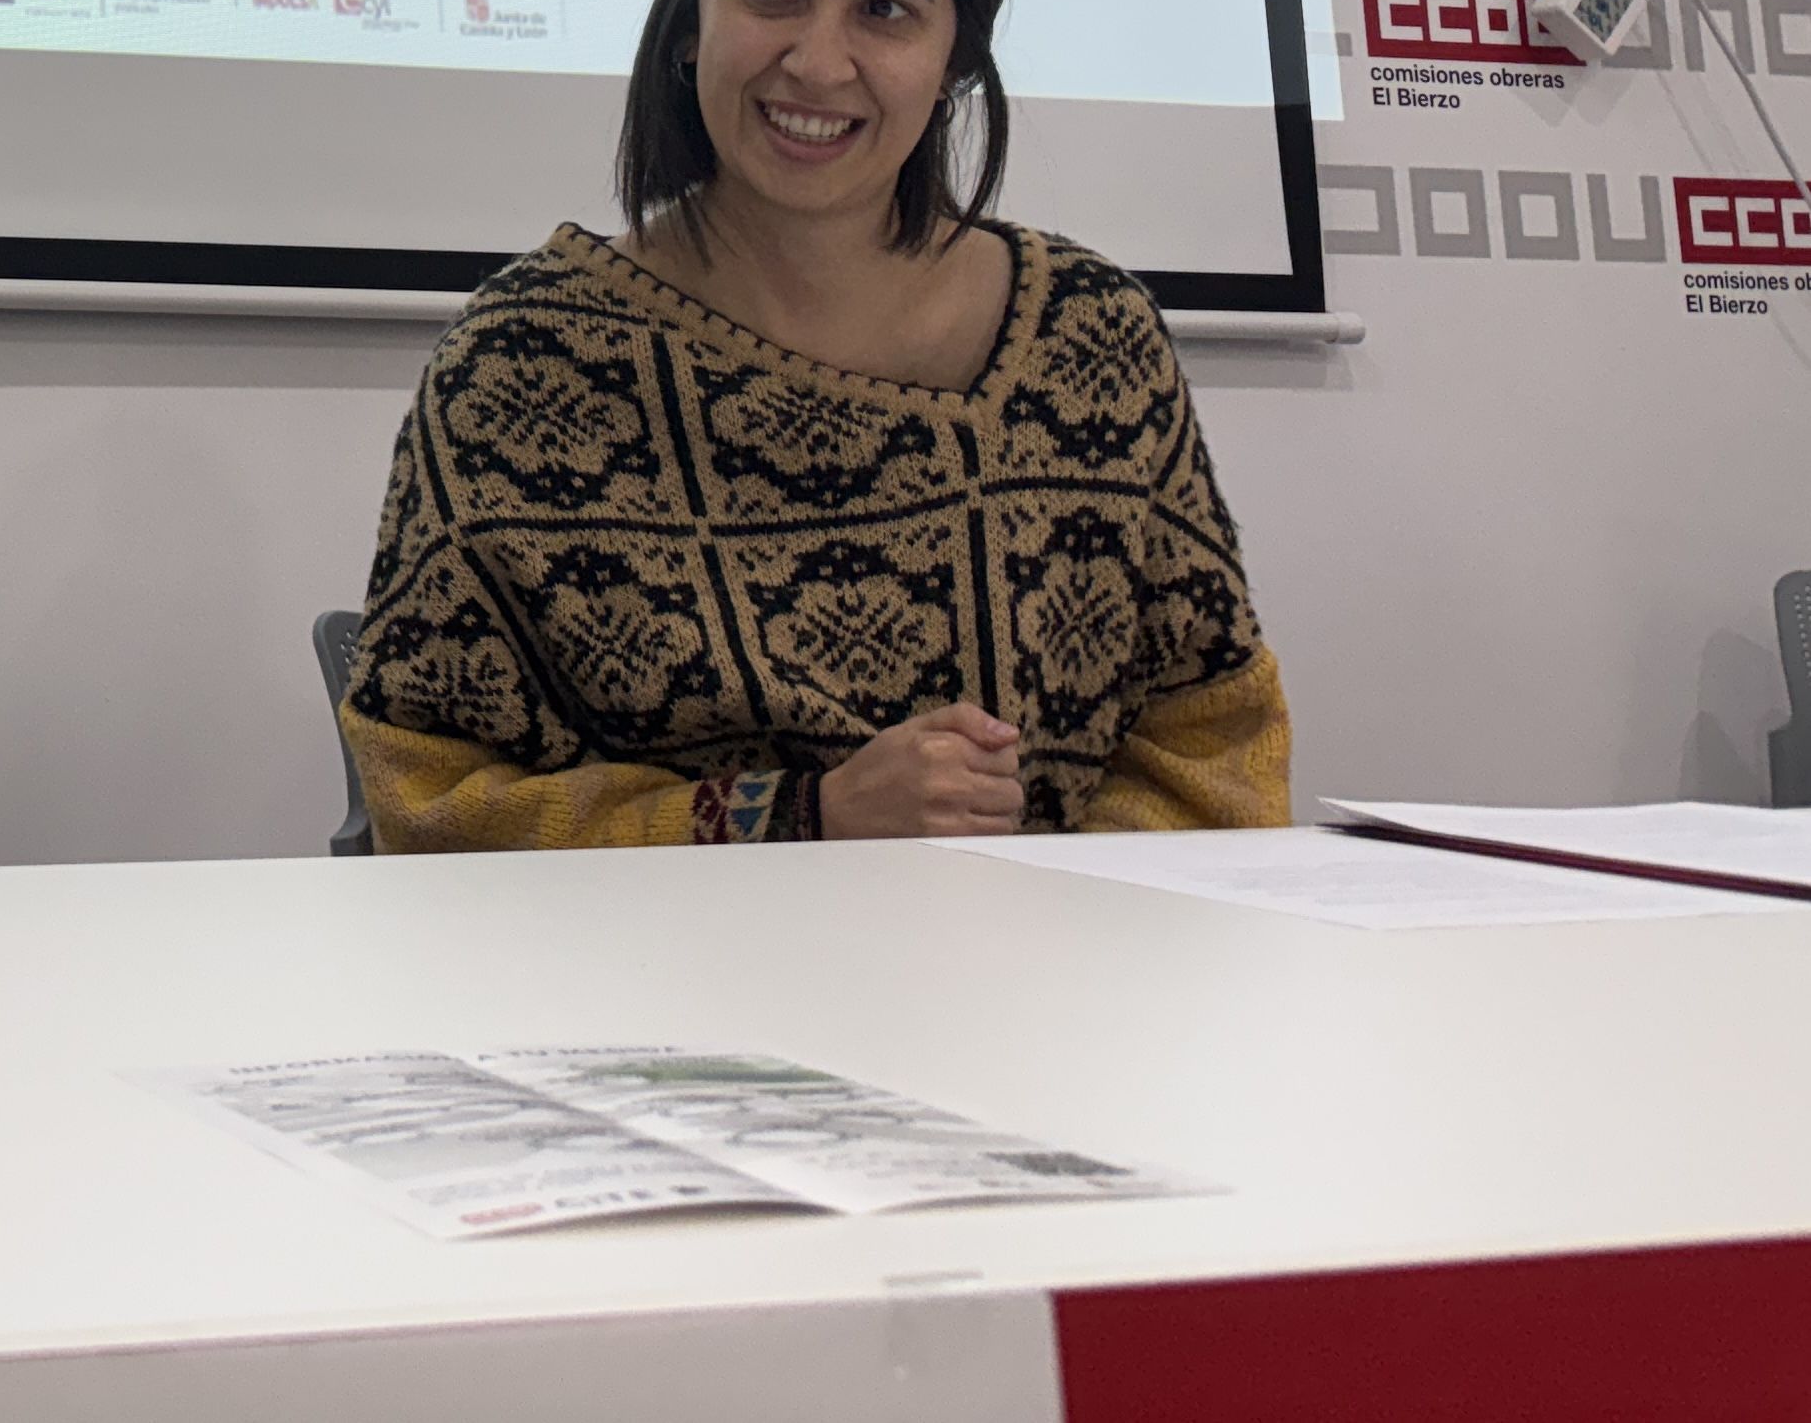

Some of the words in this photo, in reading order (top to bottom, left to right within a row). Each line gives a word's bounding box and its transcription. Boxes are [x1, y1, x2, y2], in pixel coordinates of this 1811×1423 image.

[1371, 63, 1484, 85] comisiones
[1489, 67, 1565, 90] obreras
[1373, 87, 1390, 105] El
[1397, 88, 1461, 109] Bierzo
[1684, 270, 1789, 291] comisiones
[1686, 294, 1703, 313] El
[1709, 294, 1768, 314] Bierzo
